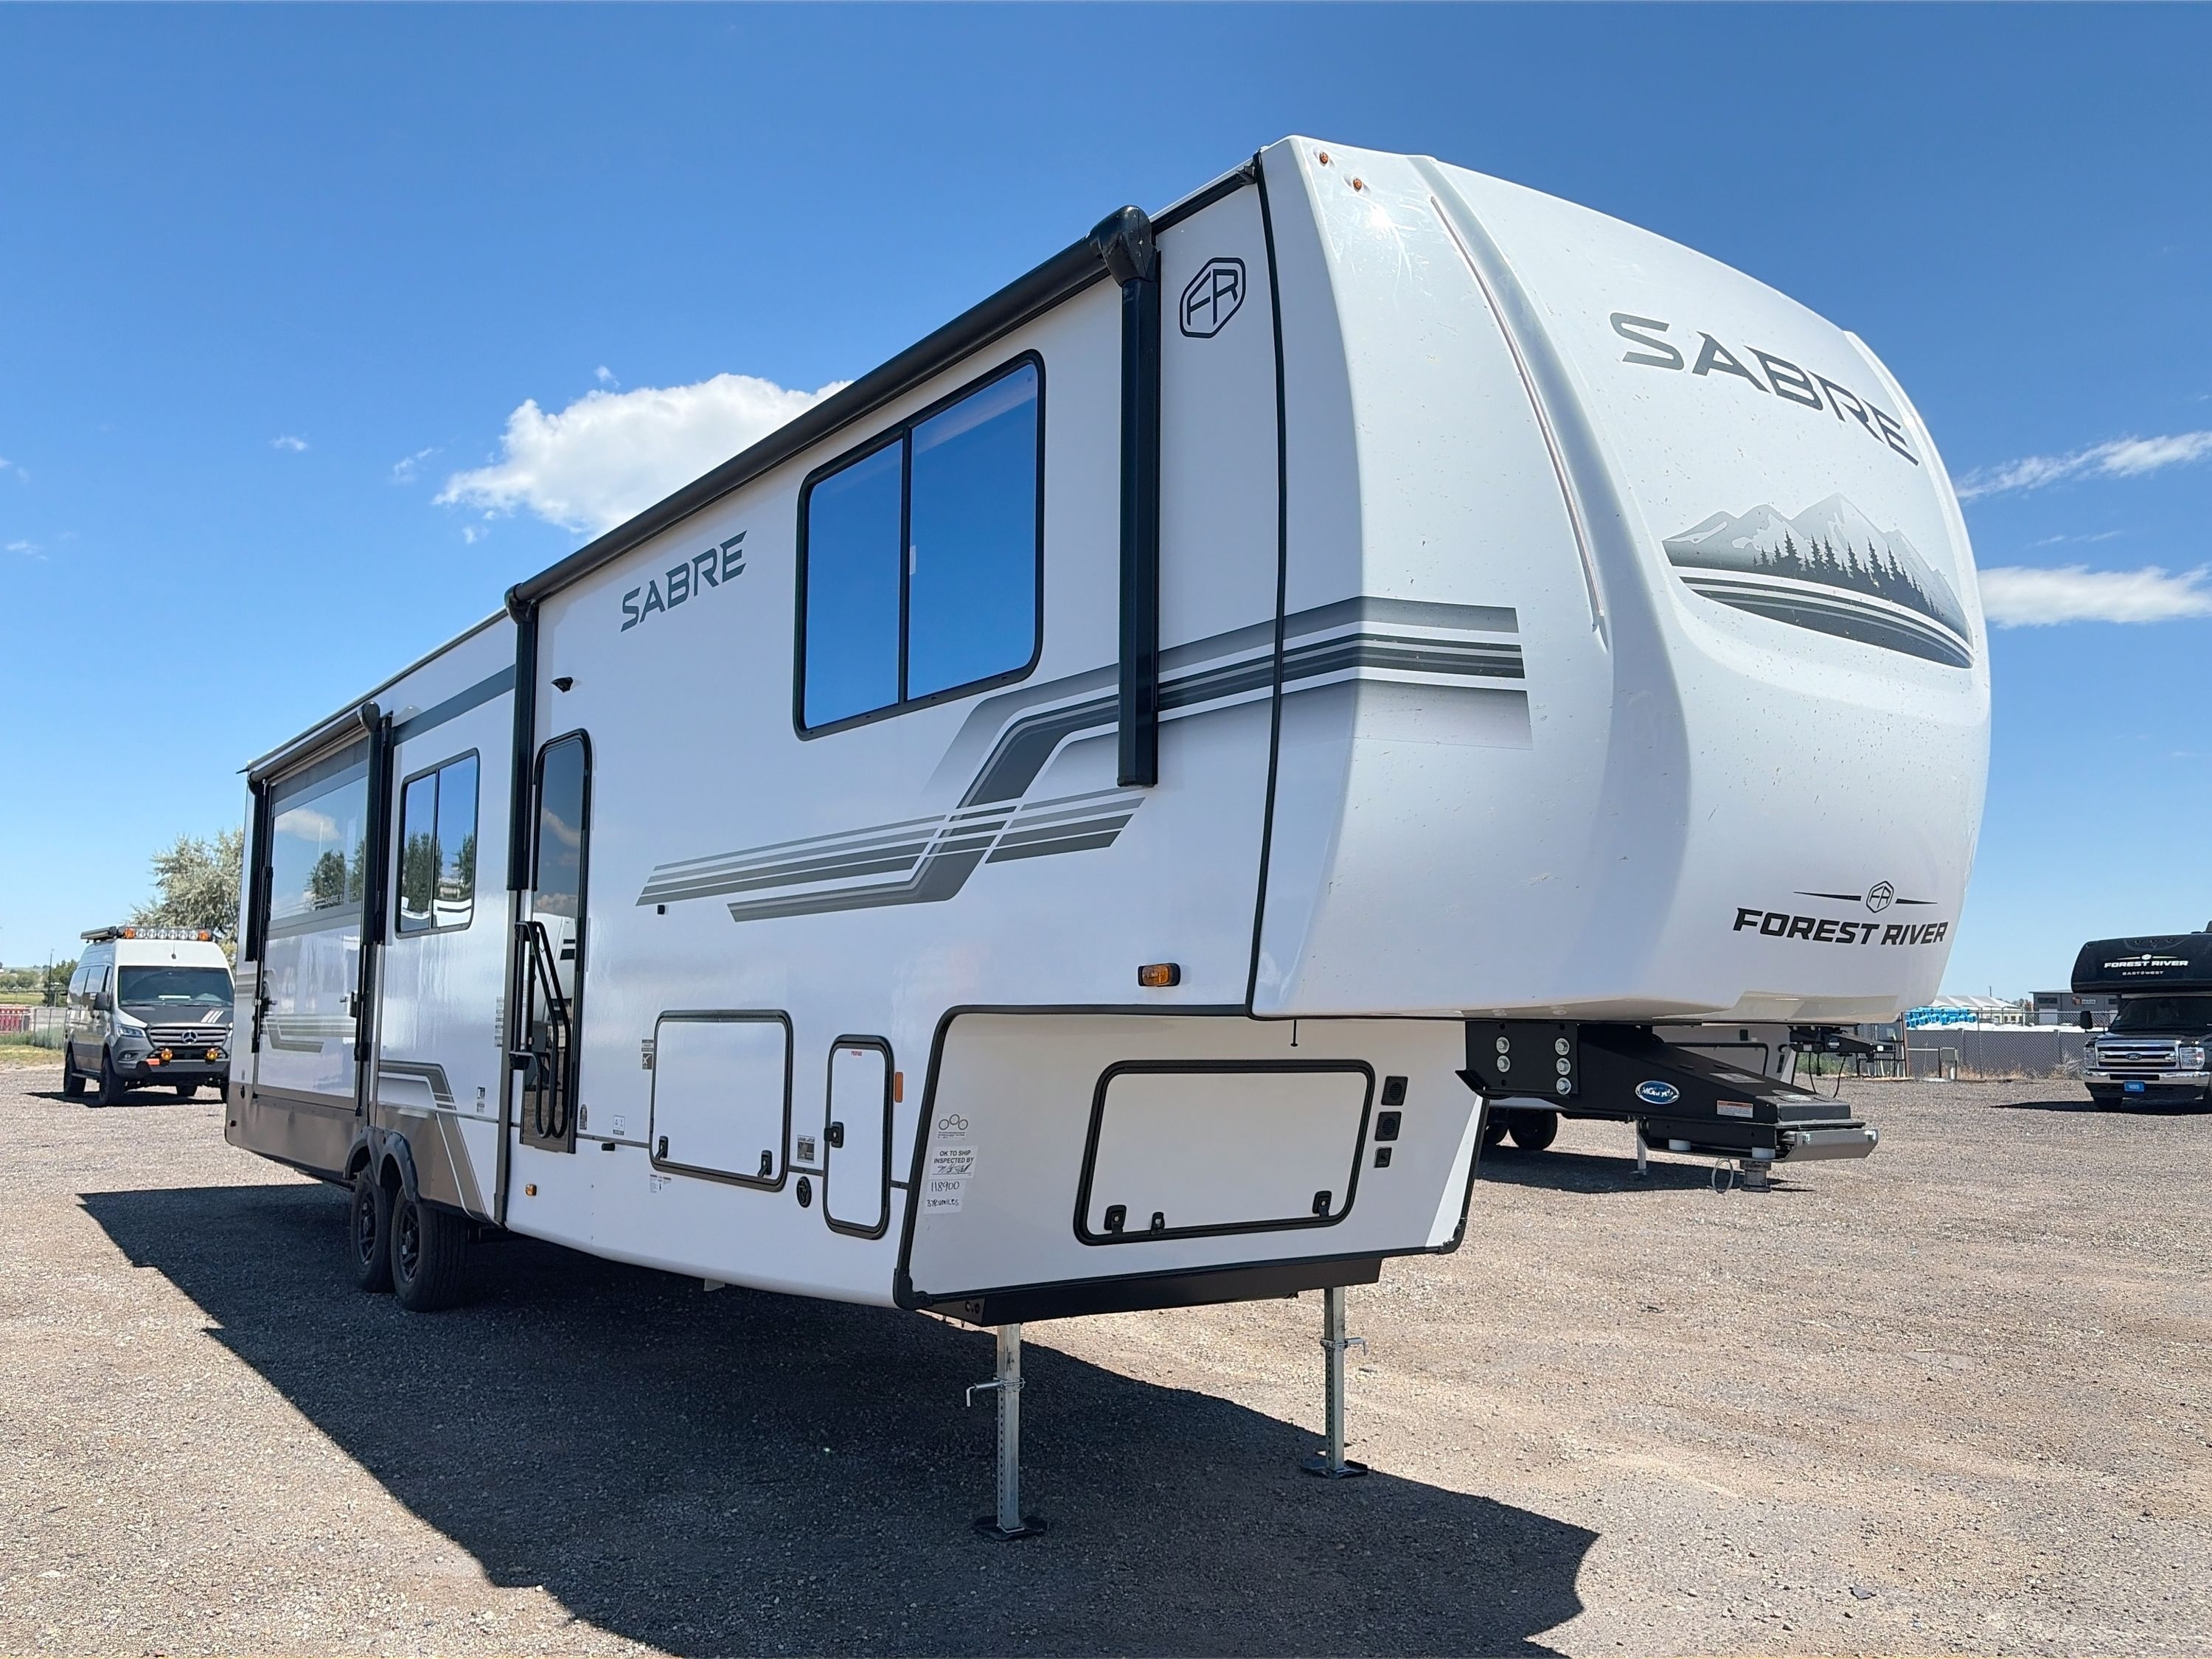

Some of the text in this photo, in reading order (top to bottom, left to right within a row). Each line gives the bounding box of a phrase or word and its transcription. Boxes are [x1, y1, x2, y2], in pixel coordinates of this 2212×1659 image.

[1609, 312, 1919, 467] SABRE
[620, 529, 748, 633] SABRE
[1733, 908, 1949, 945] FOREST RIVER
[931, 1181, 960, 1192] 118900
